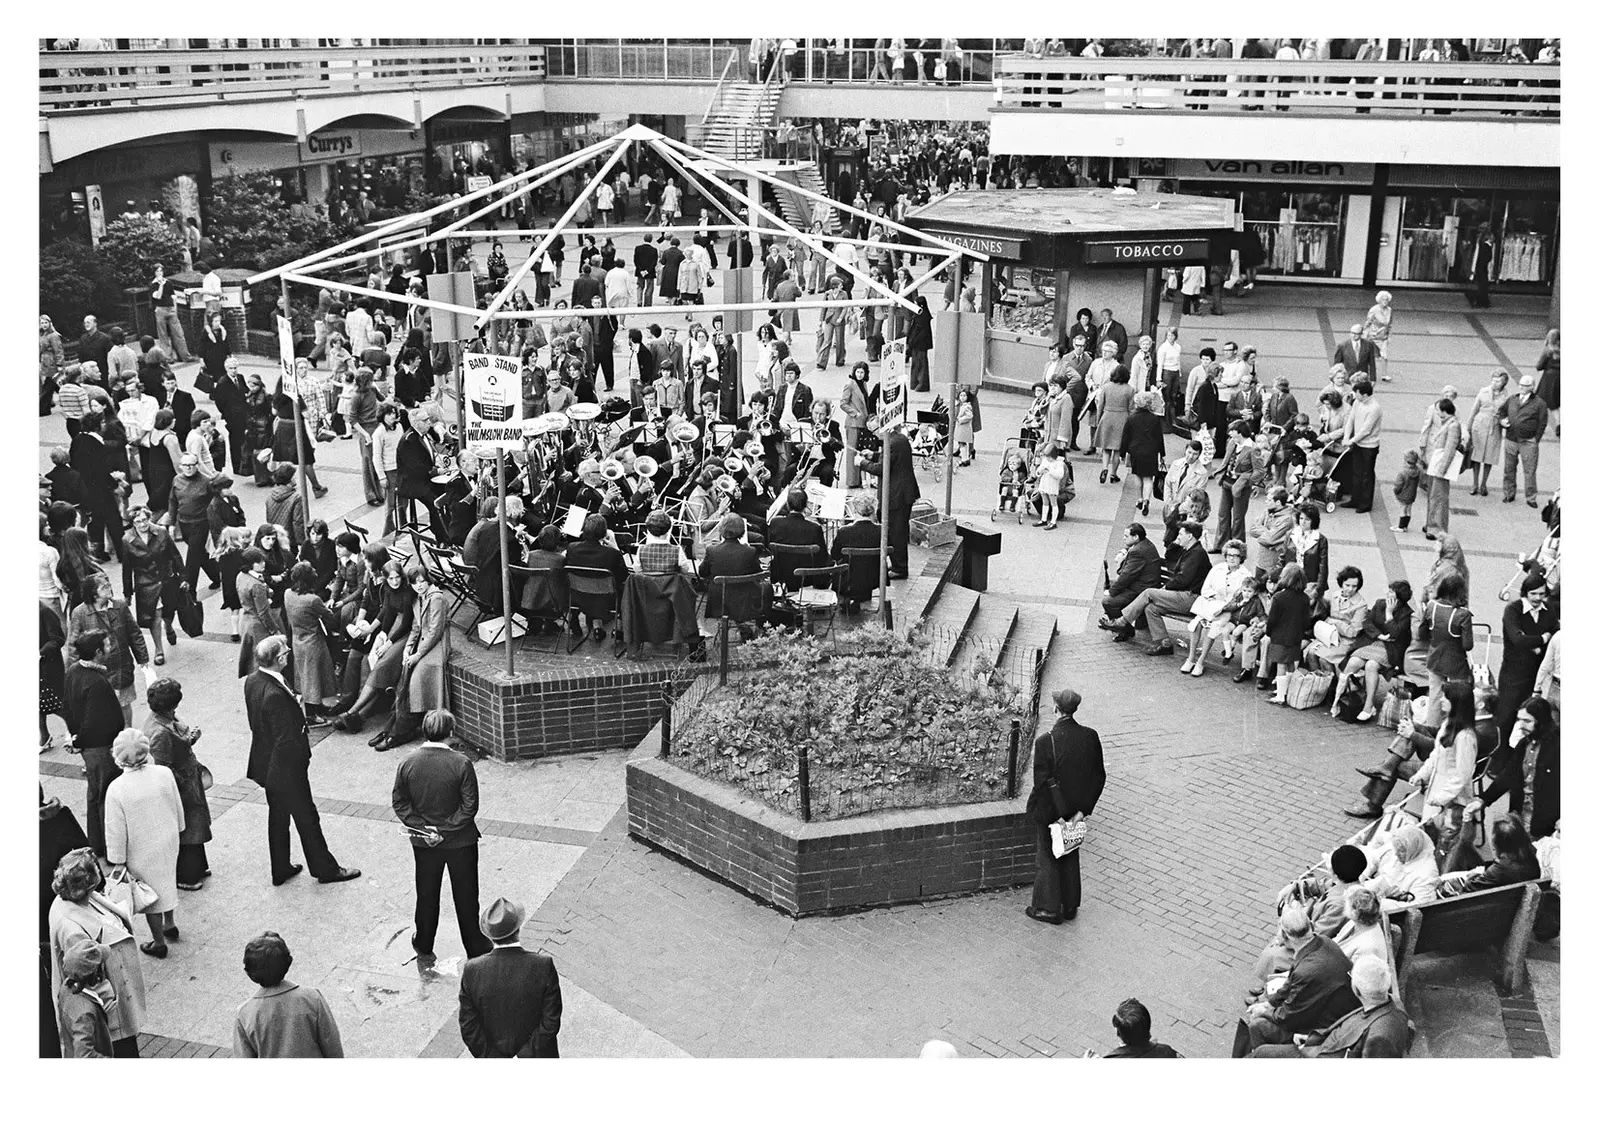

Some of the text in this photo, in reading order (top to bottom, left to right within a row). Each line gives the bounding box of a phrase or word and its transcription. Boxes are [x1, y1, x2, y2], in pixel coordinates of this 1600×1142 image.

[308, 136, 353, 153] Currys
[1204, 159, 1344, 176] van allan
[1114, 245, 1183, 258] TOBACCO
[468, 357, 518, 374] BAND STAND
[467, 428, 503, 441] WILMSLOW
[503, 428, 523, 441] BAND
